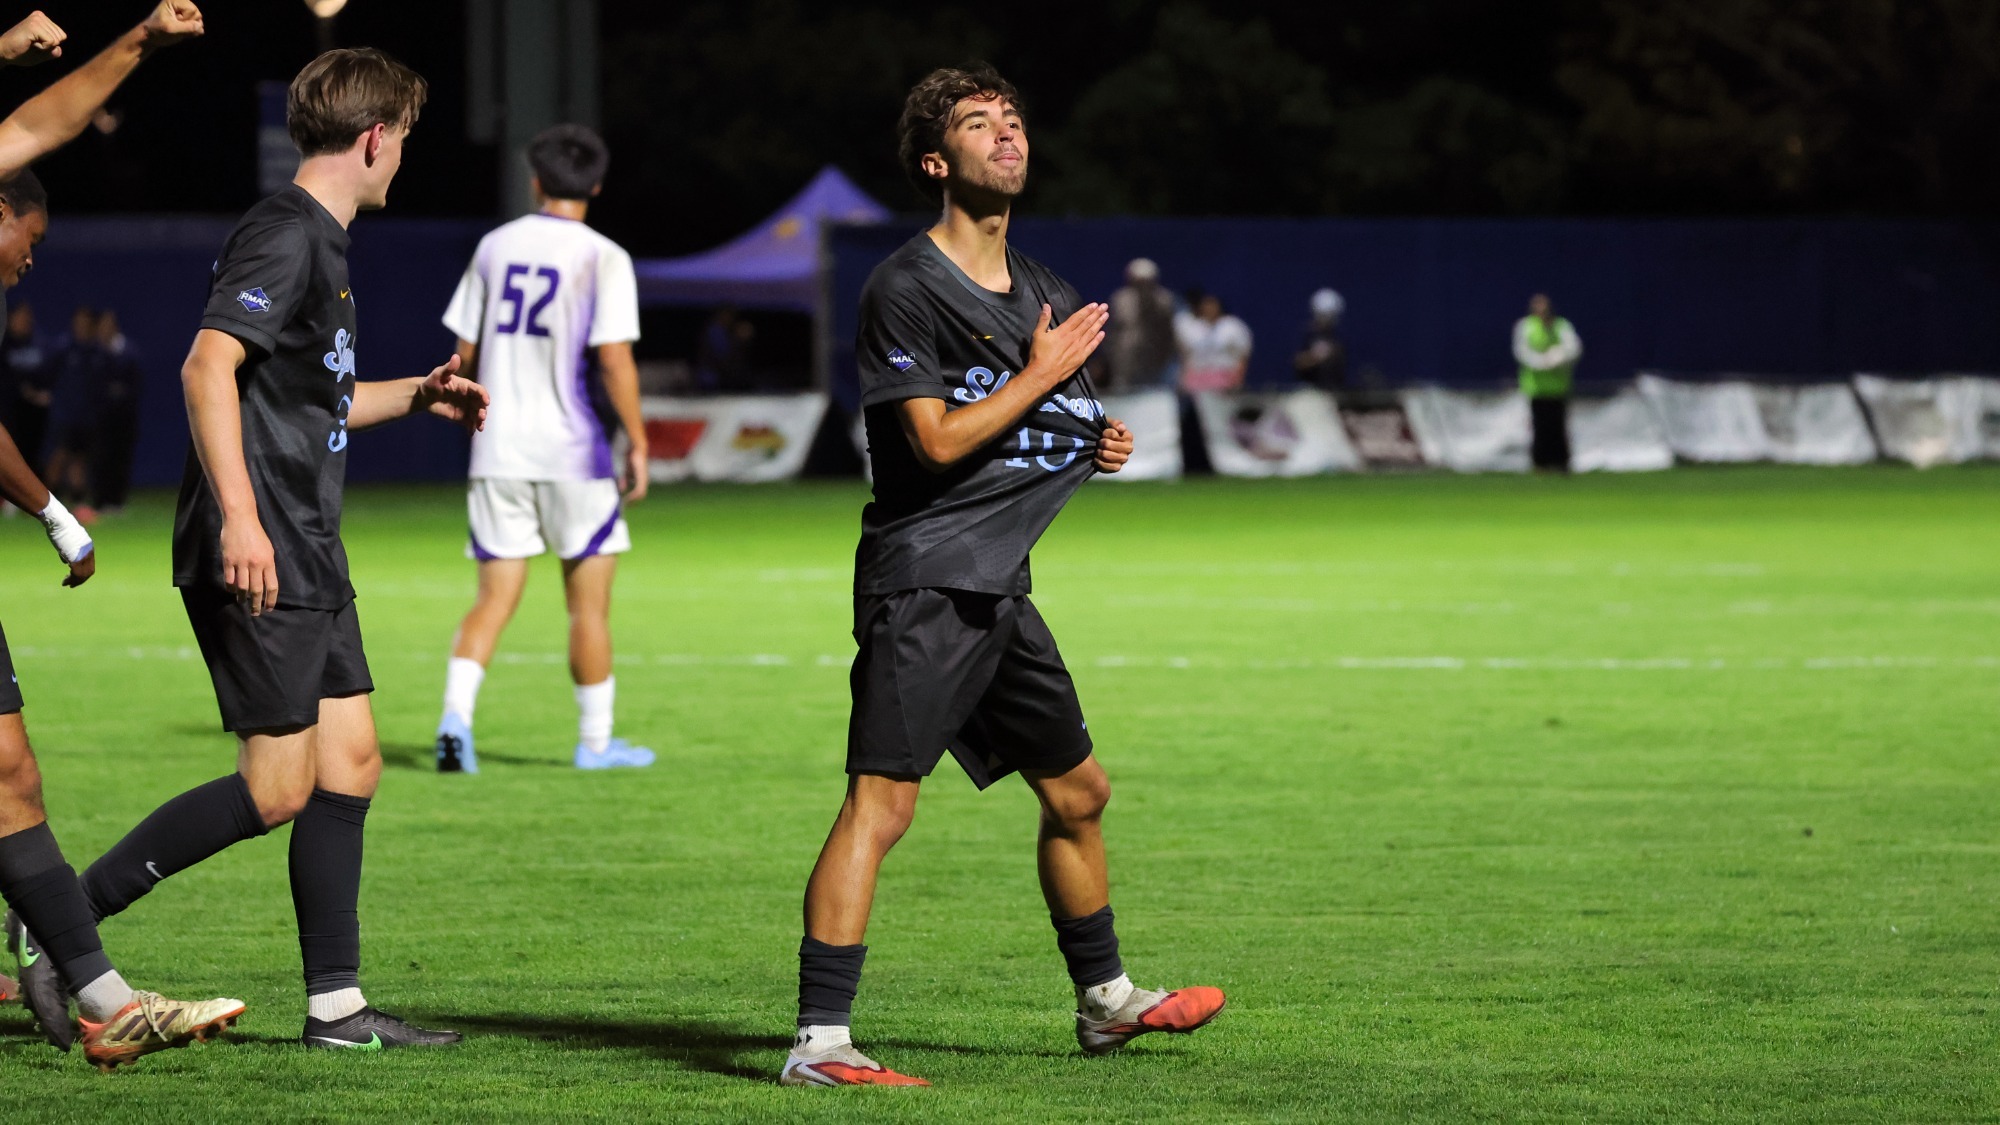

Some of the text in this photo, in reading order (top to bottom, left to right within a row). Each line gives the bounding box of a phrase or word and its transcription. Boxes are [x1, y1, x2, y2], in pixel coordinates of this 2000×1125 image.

[240, 292, 270, 309] RMAC
[496, 263, 560, 337] 52
[1005, 426, 1085, 472] 10
